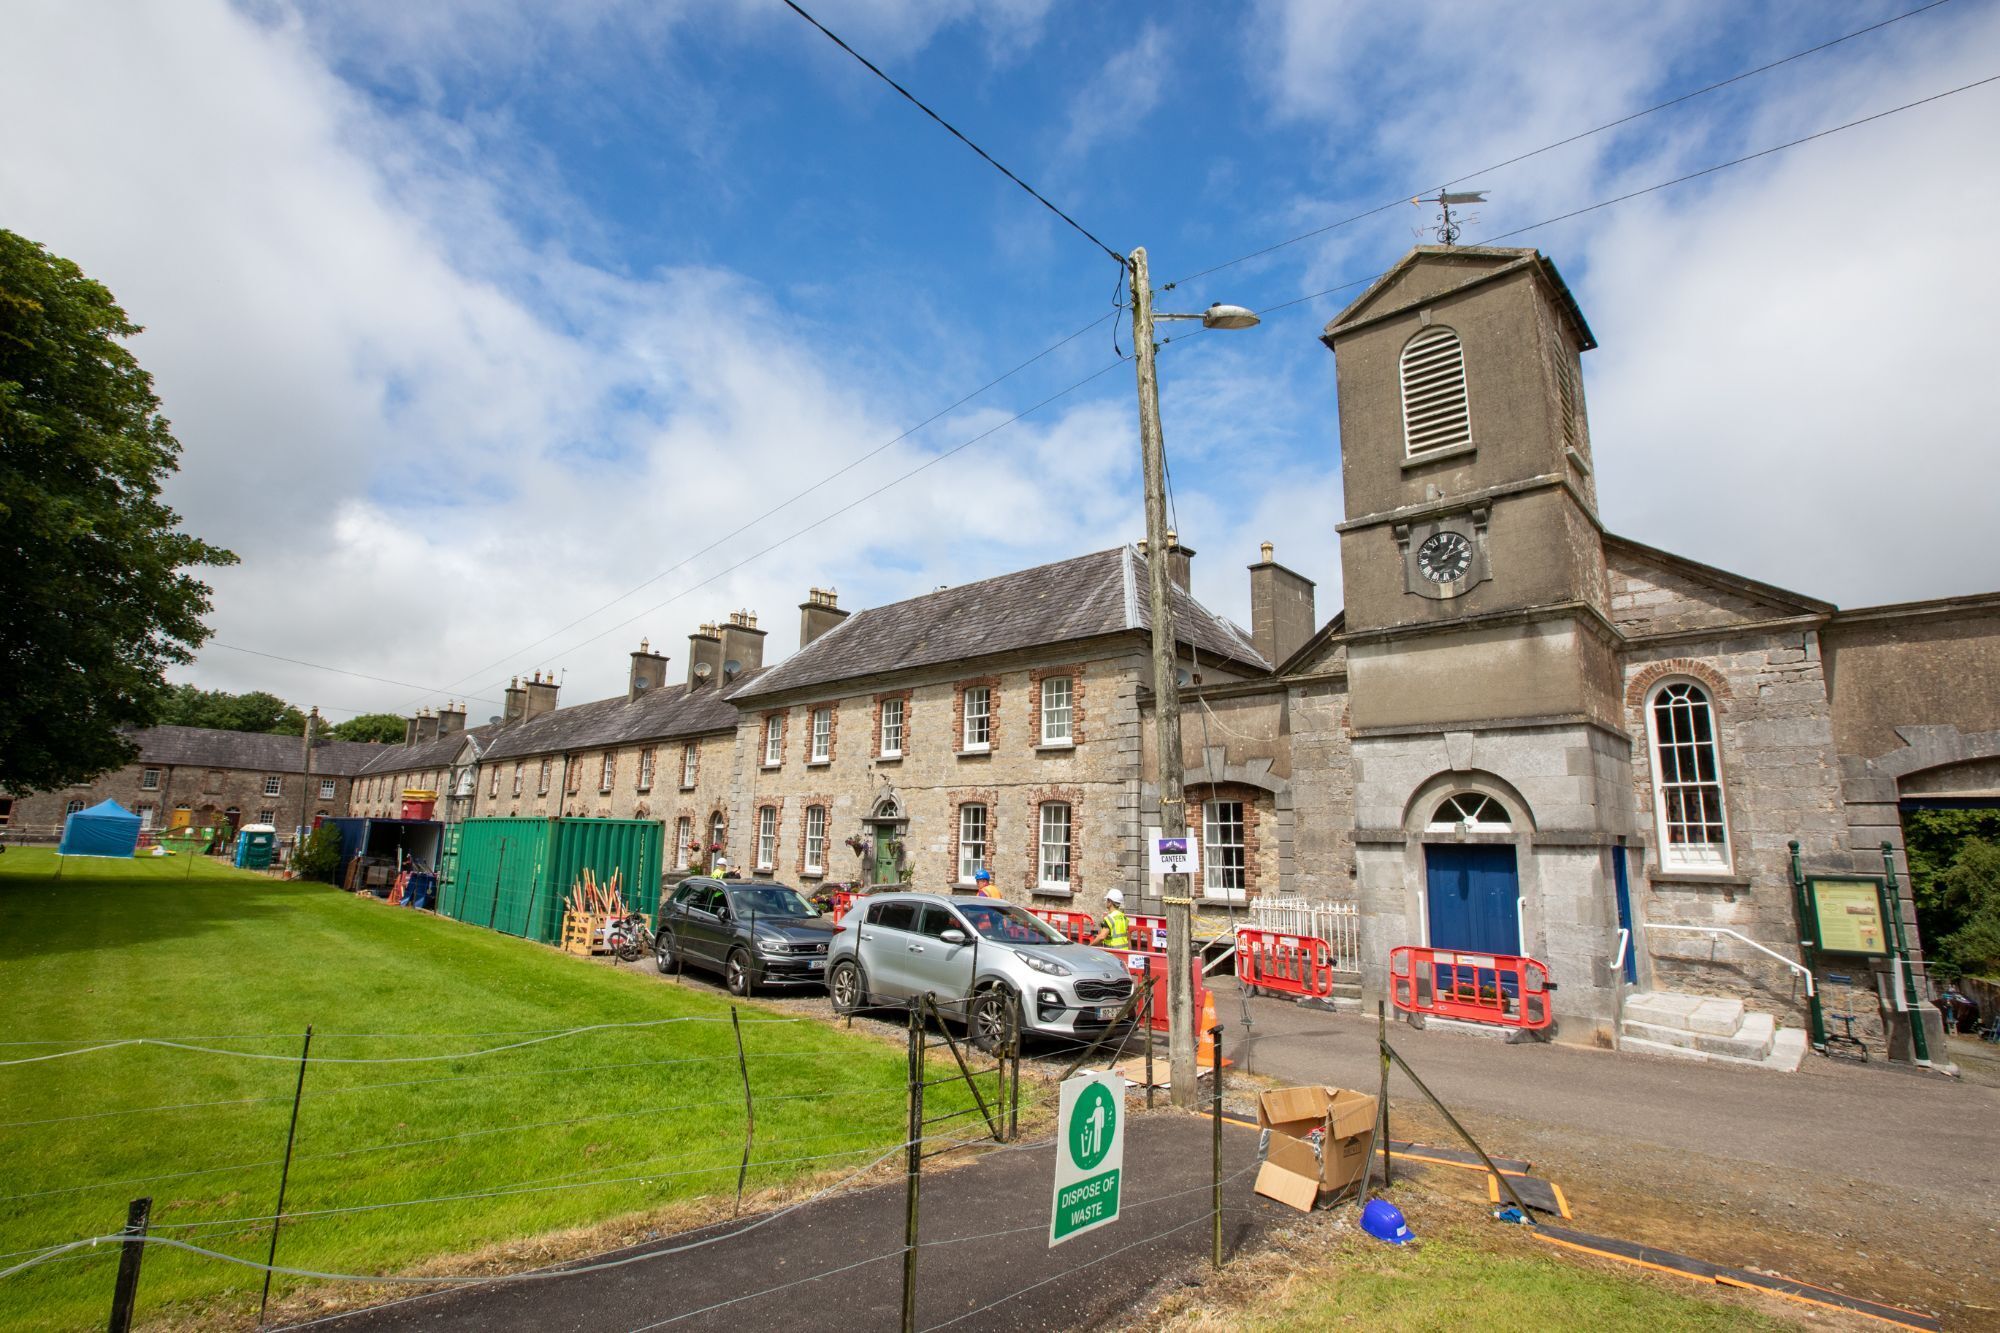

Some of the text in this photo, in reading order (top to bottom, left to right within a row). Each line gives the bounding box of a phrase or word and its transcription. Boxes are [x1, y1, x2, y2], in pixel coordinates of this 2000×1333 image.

[1471, 212, 1480, 225] E
[1411, 224, 1424, 238] W
[1161, 855, 1186, 863] CANTEEN
[1062, 1176, 1115, 1208] DISPOSE OF
[1071, 1201, 1103, 1226] WASTE
